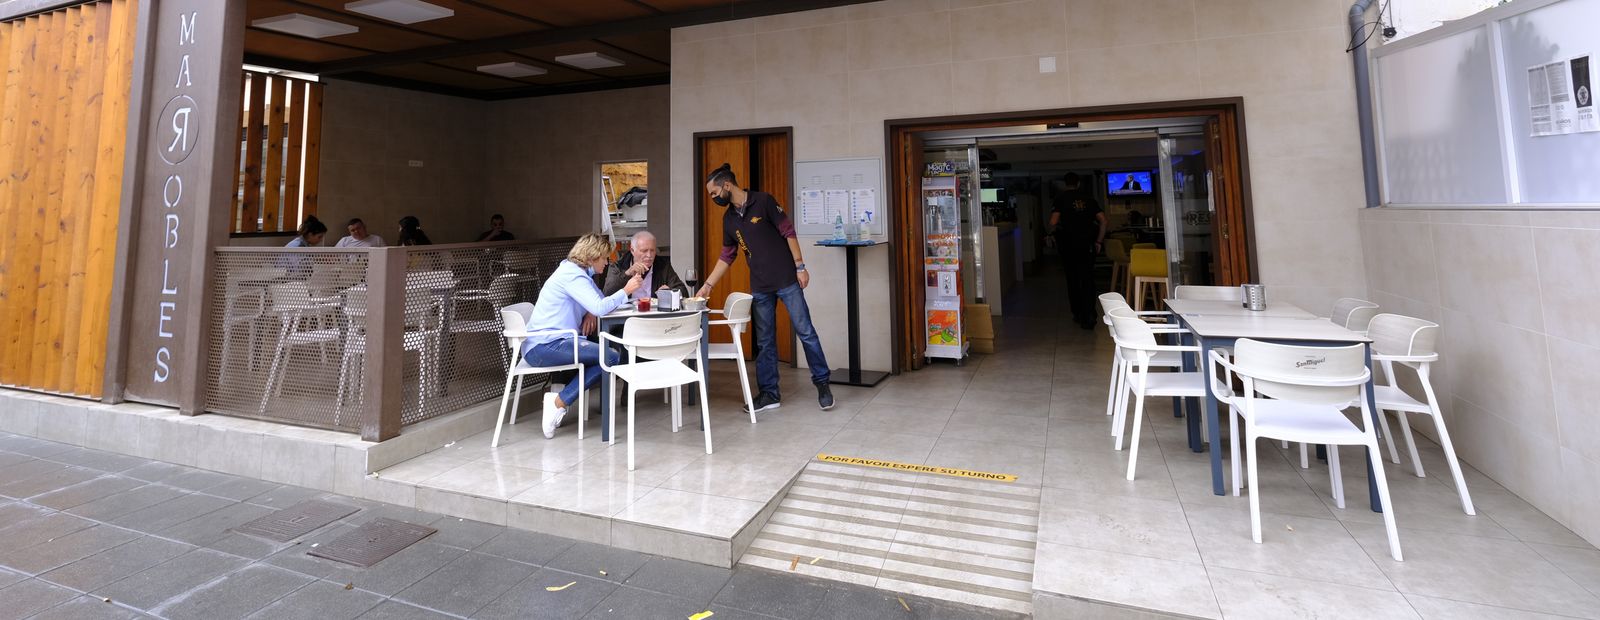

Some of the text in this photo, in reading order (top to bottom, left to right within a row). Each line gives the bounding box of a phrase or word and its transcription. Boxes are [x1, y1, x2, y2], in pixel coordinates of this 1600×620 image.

[851, 458, 891, 467] FAVOR
[893, 464, 937, 473] ESPERE
[961, 470, 1006, 480] TURNO
